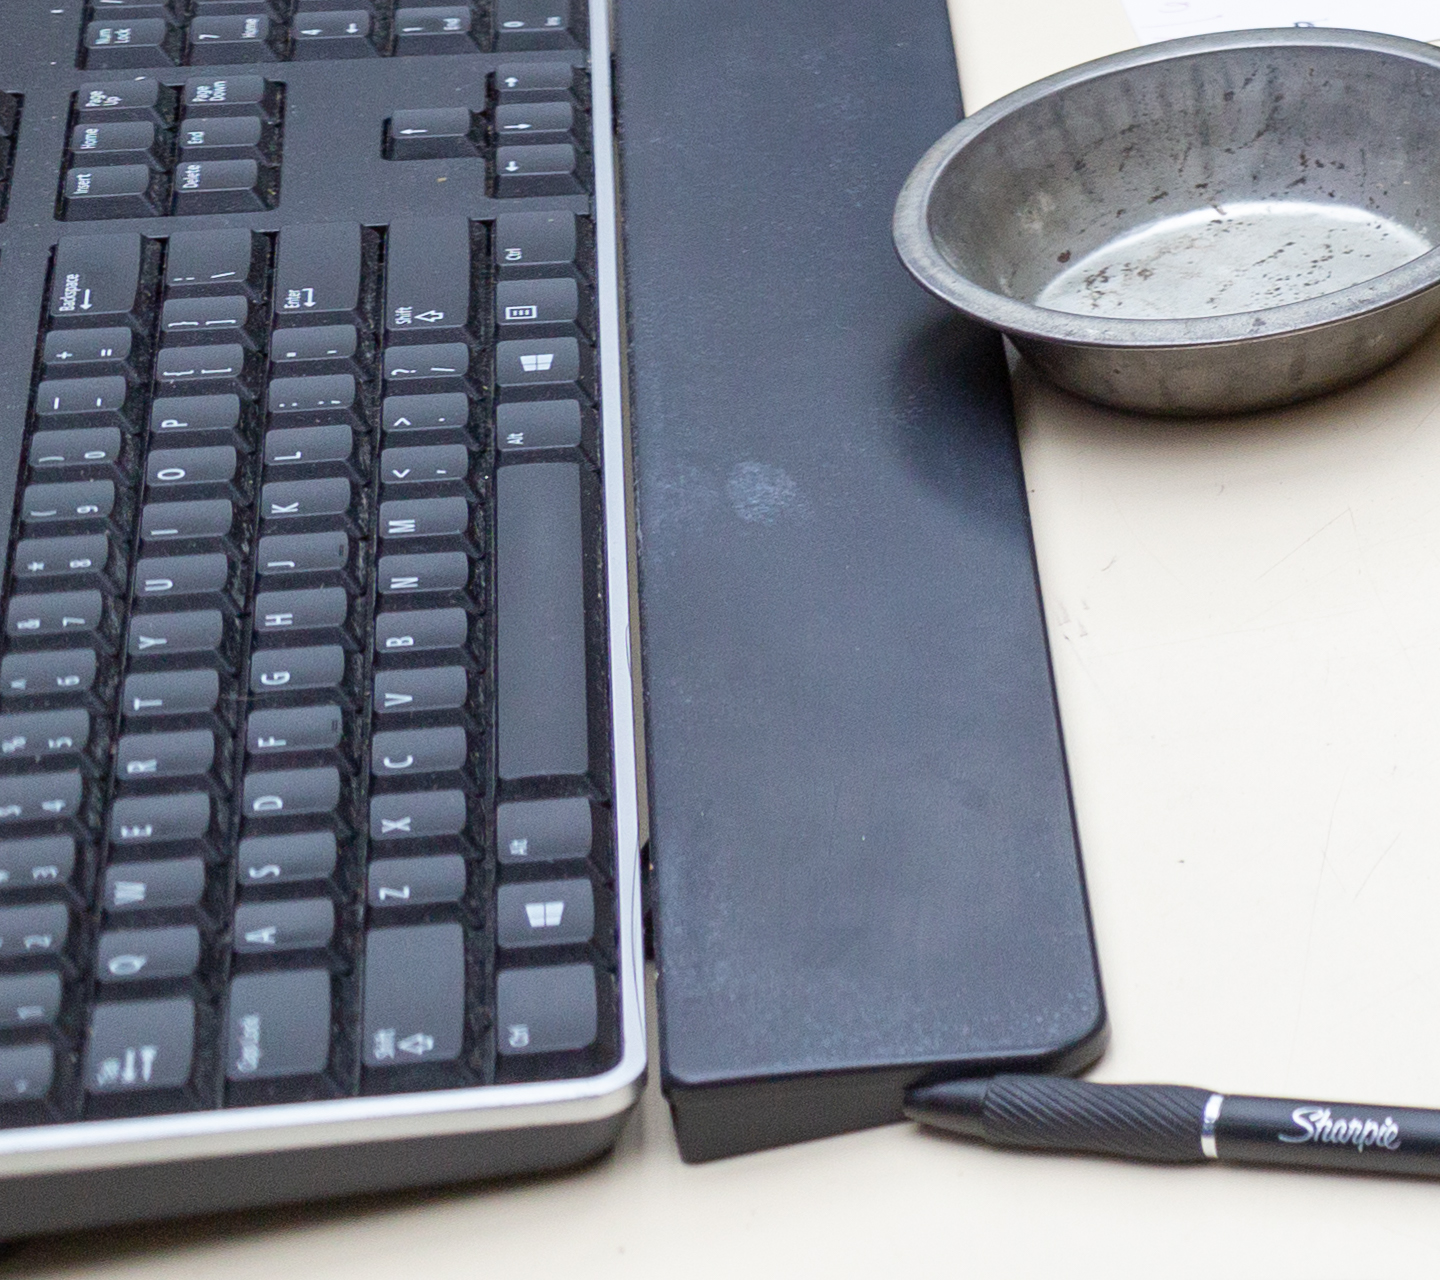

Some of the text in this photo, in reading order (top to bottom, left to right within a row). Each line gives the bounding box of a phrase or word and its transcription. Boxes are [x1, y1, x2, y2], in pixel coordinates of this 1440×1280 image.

[242, 18, 259, 39] Home
[503, 20, 525, 28] 0
[95, 28, 112, 45] Num
[114, 27, 131, 44] Lock
[192, 85, 212, 103] Page
[210, 80, 228, 102] Down
[85, 90, 106, 108] Page
[103, 96, 123, 107] Up
[80, 128, 99, 150] Home
[187, 131, 205, 145] End
[182, 164, 202, 189] Delete
[73, 173, 92, 195] Insert
[505, 247, 523, 261] Ctrl
[58, 273, 81, 313] Backspace
[283, 288, 301, 309] Enter
[394, 306, 413, 325] Shift
[161, 419, 188, 429] P
[506, 432, 524, 445] Alt
[84, 451, 106, 459] 0
[273, 451, 302, 461] L
[157, 468, 186, 480] O
[76, 505, 99, 514] 9
[271, 502, 299, 514] K
[388, 519, 416, 534] M
[69, 558, 92, 569] 8
[267, 560, 295, 568] J
[145, 579, 174, 591] U
[390, 576, 419, 589] N
[62, 617, 85, 627] 7
[264, 613, 293, 627] H
[138, 635, 167, 650] Y
[385, 636, 414, 648] B
[56, 675, 80, 686] 6
[260, 671, 291, 686] G
[133, 698, 163, 711] T
[384, 693, 413, 707] V
[48, 737, 73, 749] 5
[257, 736, 287, 748] F
[126, 758, 157, 774] R
[383, 755, 414, 769] C
[41, 799, 66, 813] 4
[253, 795, 283, 811] D
[120, 825, 153, 838] E
[381, 816, 411, 833] X
[32, 864, 58, 880] 3
[249, 864, 281, 879] S
[113, 880, 146, 906] W
[378, 886, 410, 901] Z
[244, 925, 276, 944] A
[24, 934, 51, 950] 2
[108, 954, 147, 976] Q
[1277, 1106, 1402, 1154] Sharpie
